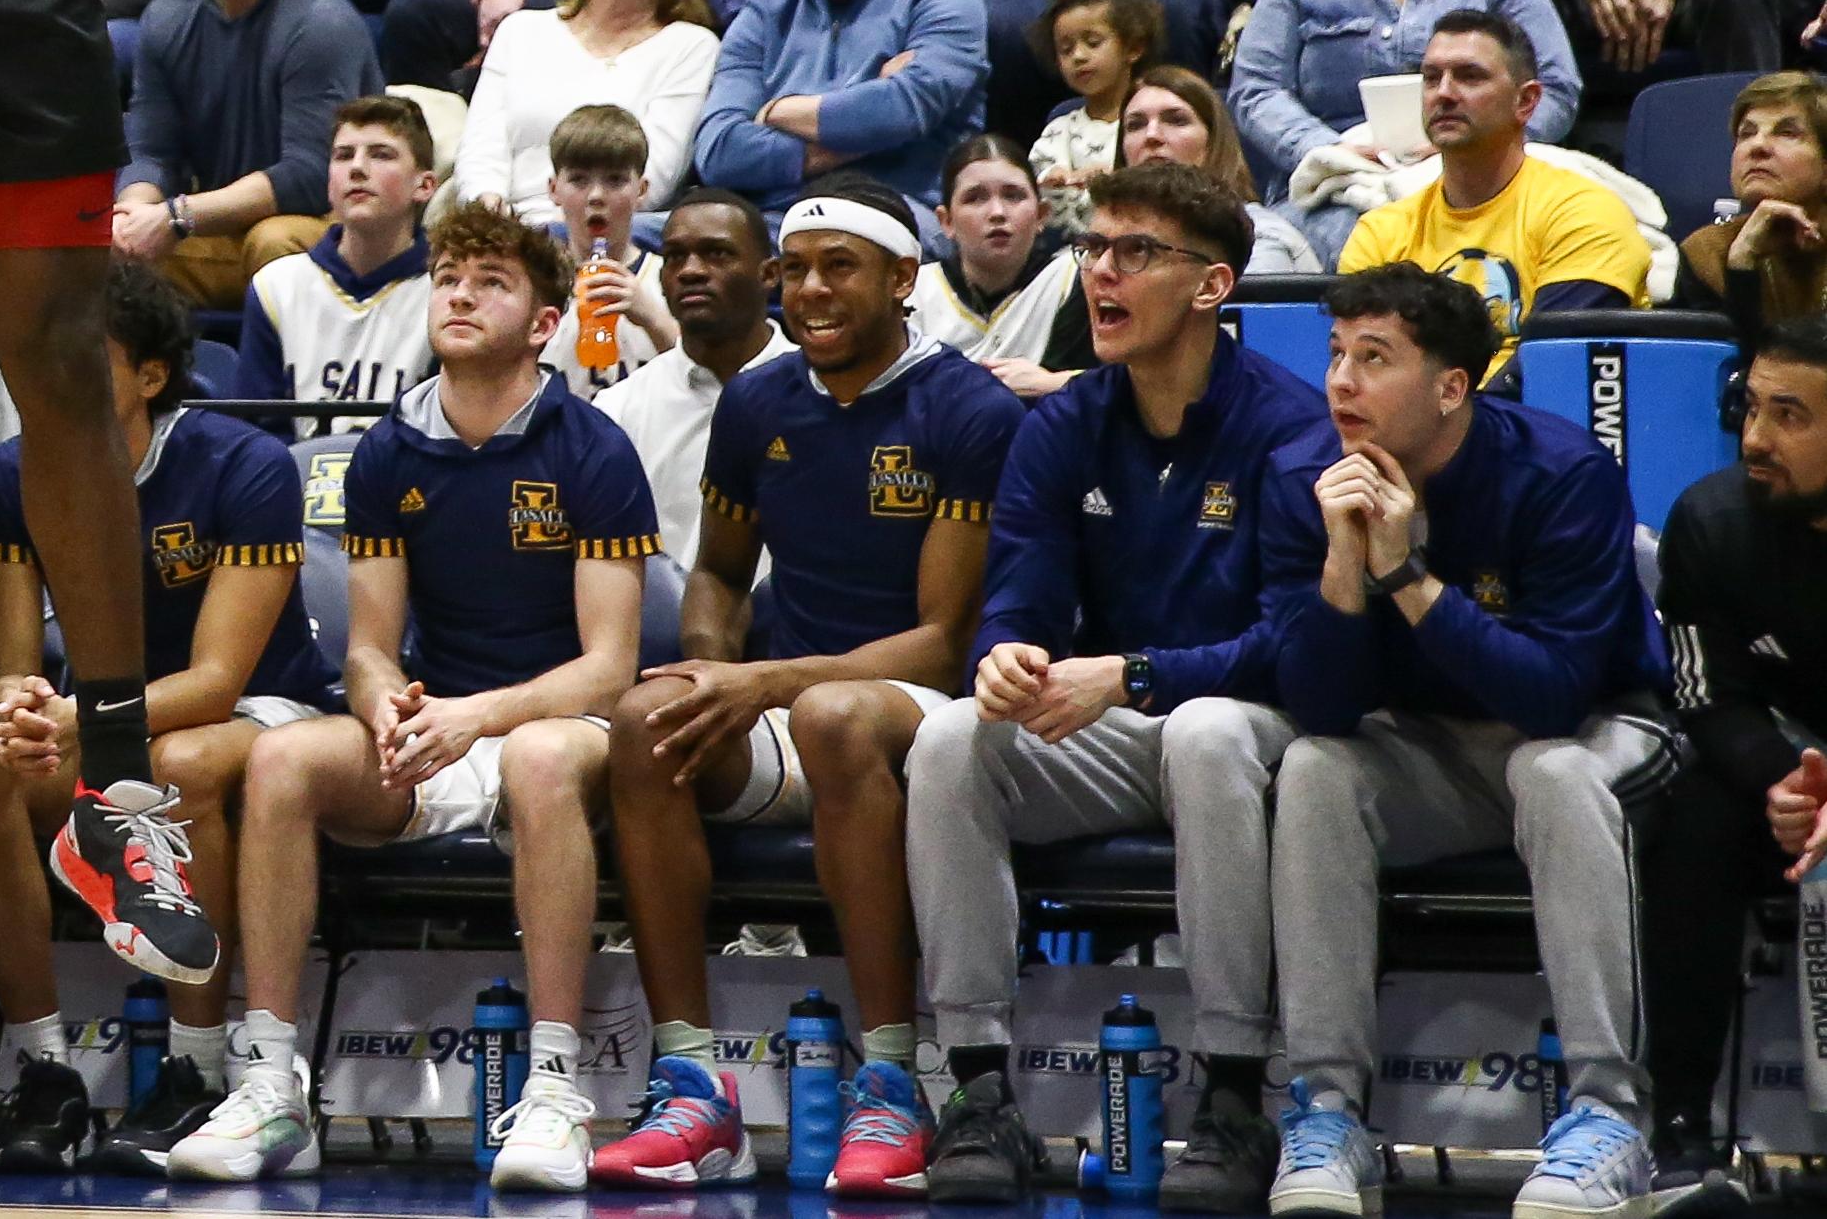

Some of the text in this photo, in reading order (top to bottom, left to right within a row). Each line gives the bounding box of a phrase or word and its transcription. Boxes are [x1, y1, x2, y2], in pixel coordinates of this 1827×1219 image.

[1592, 355, 1623, 466] POWE
[336, 1026, 477, 1065] IBEW 98
[1018, 1051, 1100, 1073] IBEW
[1379, 1052, 1543, 1093] IBEW 98
[1107, 1053, 1128, 1173] POWERADE
